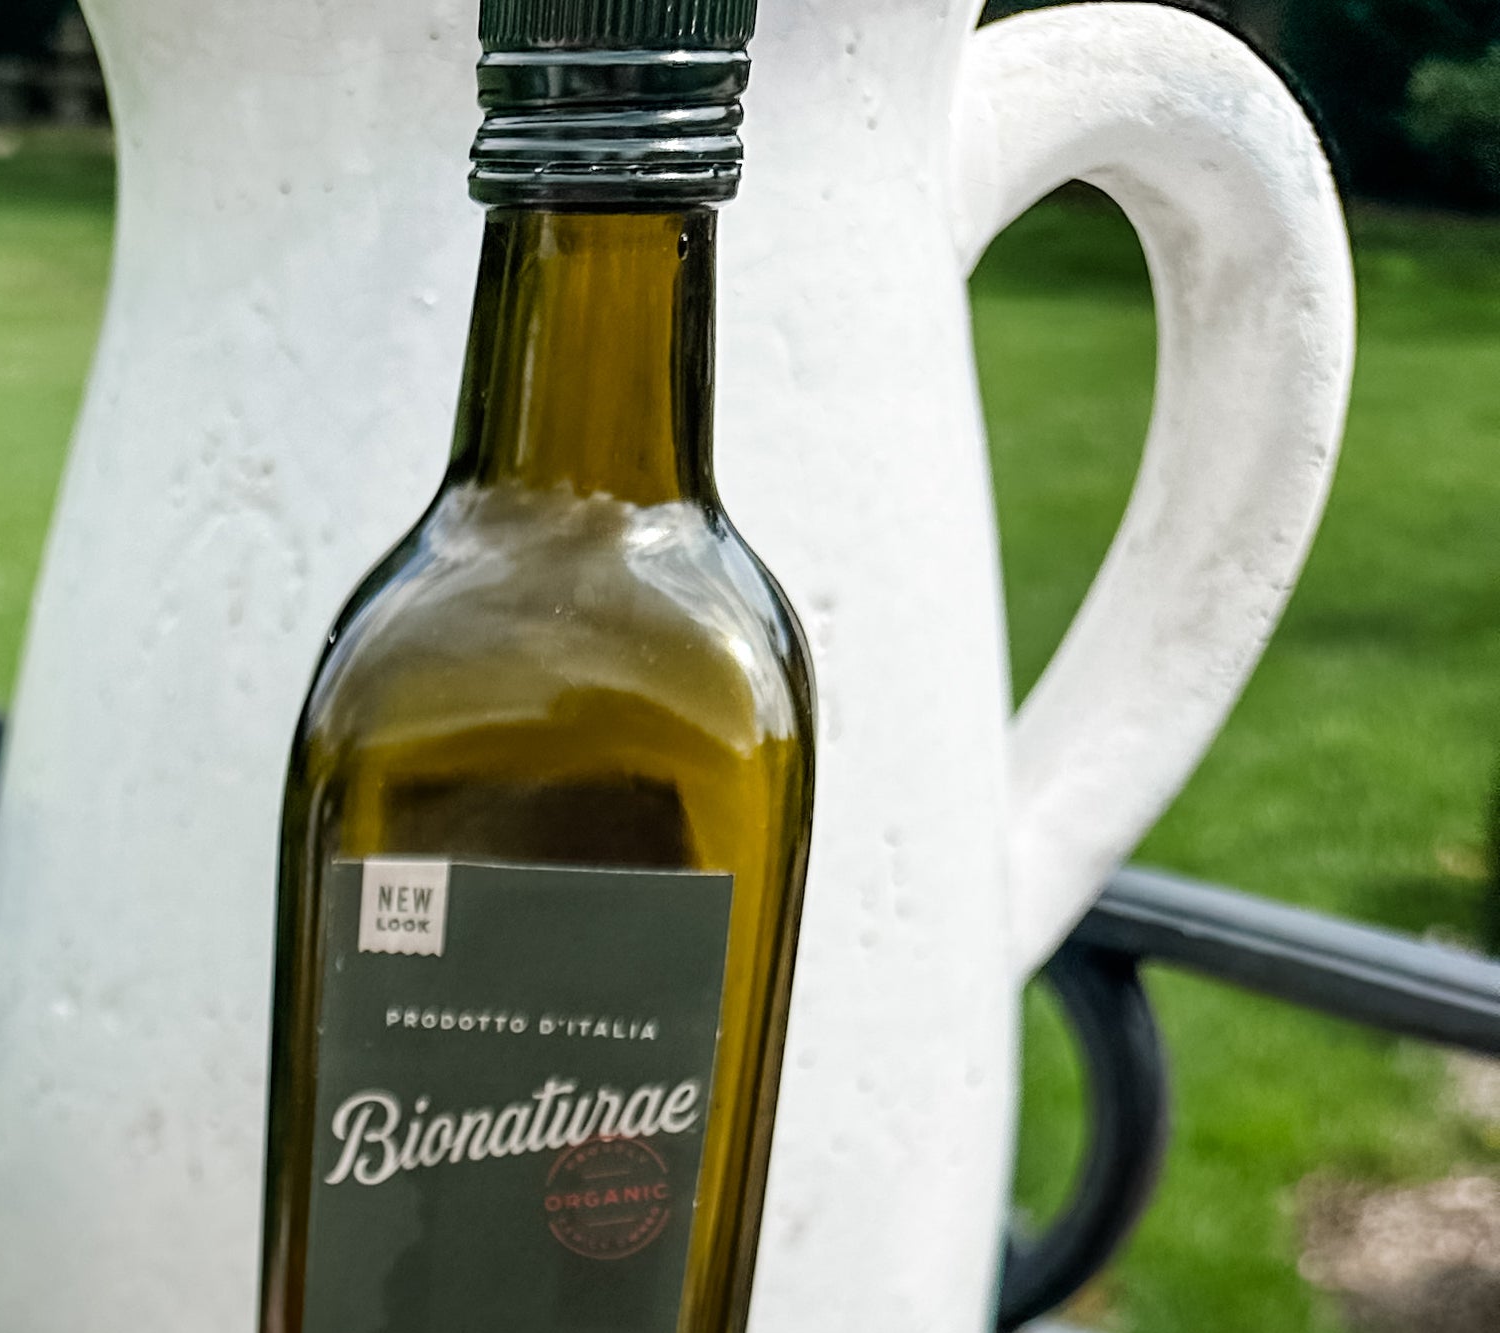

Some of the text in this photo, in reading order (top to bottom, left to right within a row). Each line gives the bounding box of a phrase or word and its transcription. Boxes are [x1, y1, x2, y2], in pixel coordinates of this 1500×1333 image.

[378, 886, 433, 913] NEW
[376, 918, 430, 933] LOOK
[386, 1010, 658, 1041] PRODOTTO D'ITALIA
[325, 1076, 701, 1185] Bionaturae
[544, 1183, 669, 1212] ORGANIC
